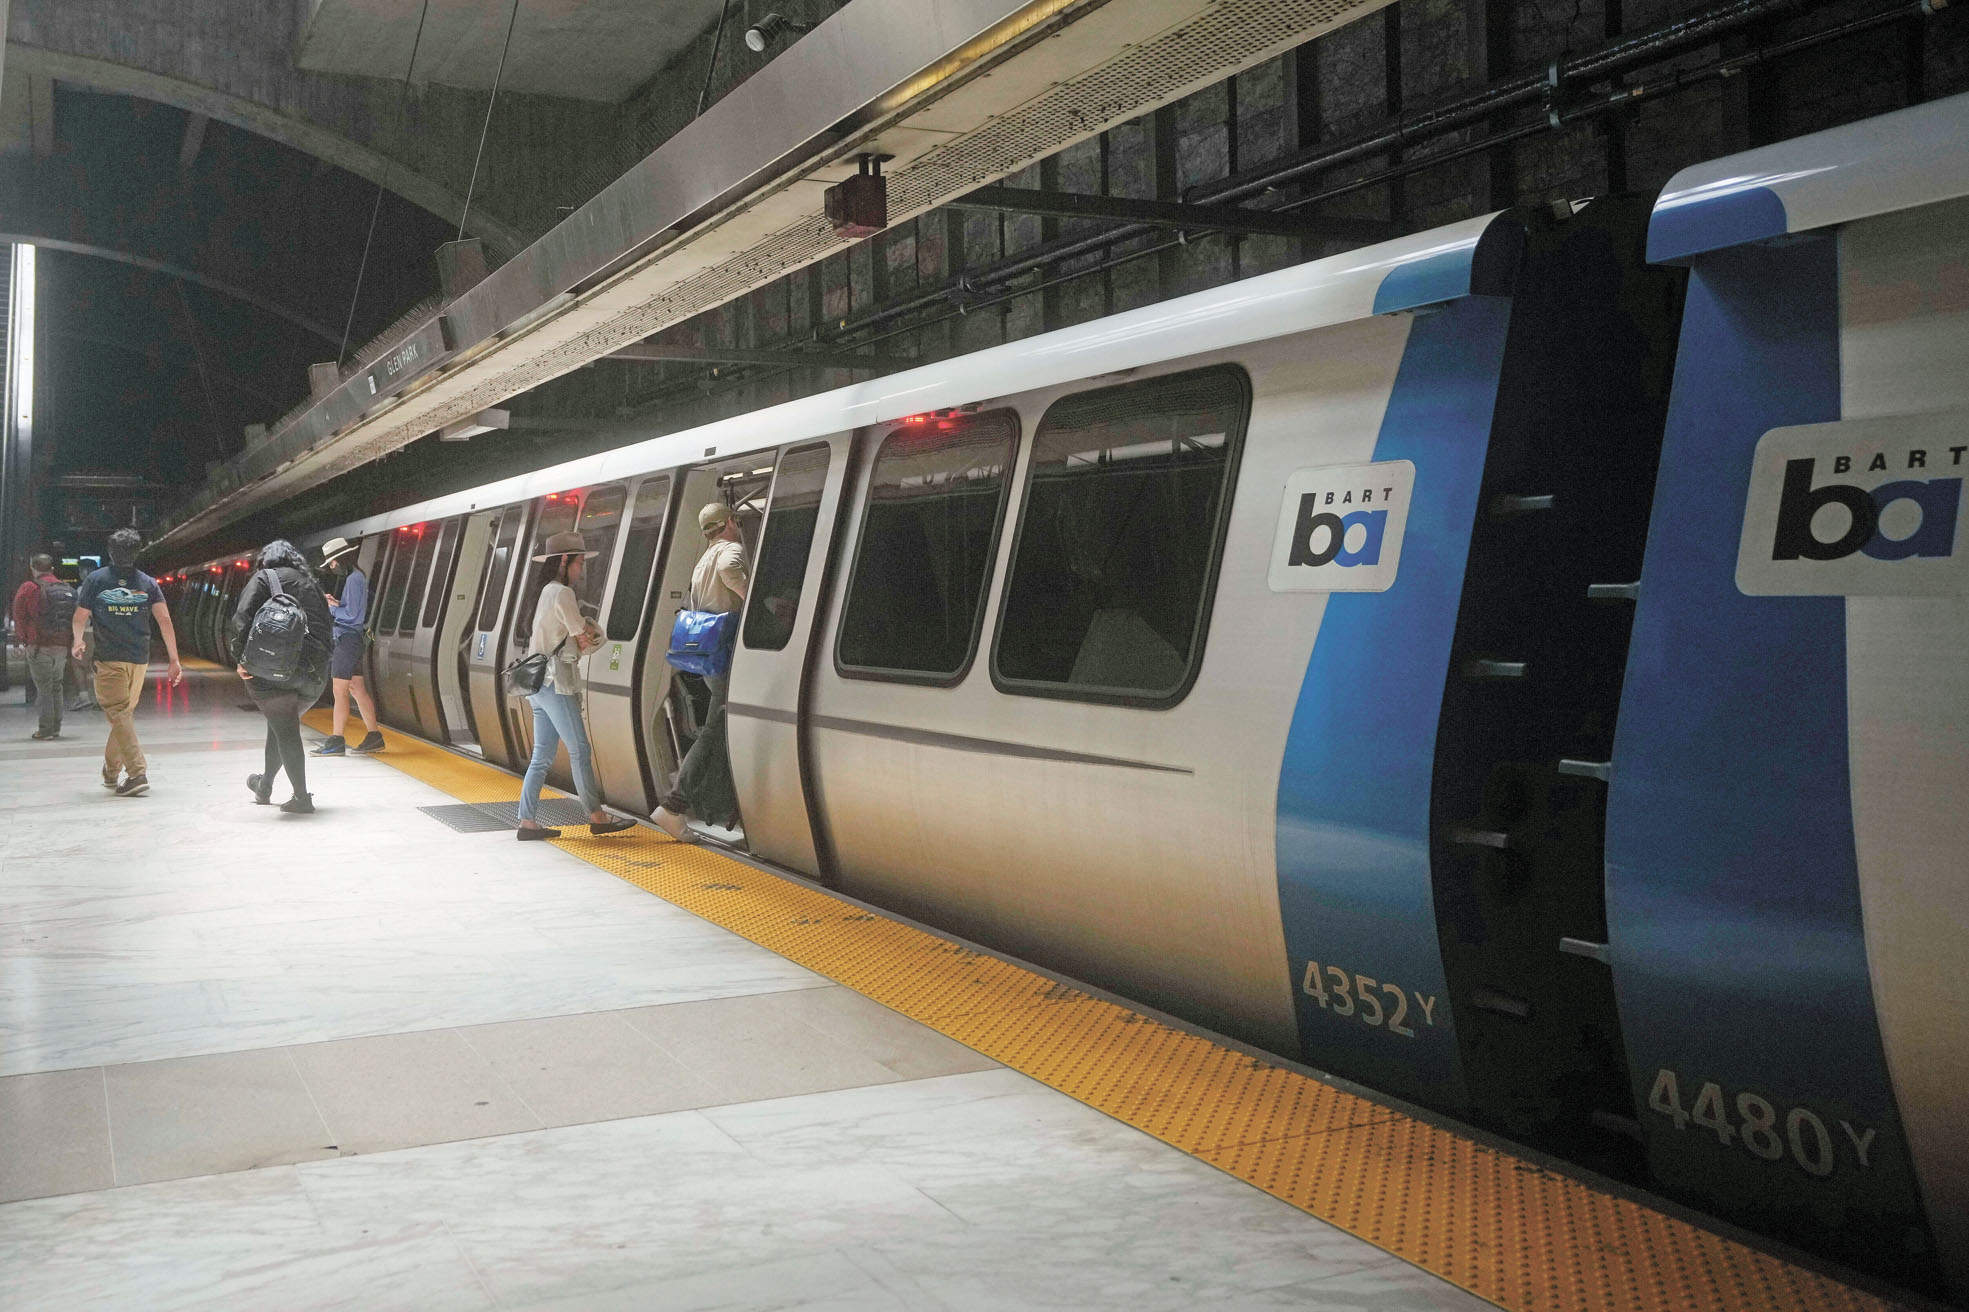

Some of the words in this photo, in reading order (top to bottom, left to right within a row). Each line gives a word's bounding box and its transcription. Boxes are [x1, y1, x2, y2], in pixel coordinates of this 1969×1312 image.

[387, 354, 403, 376] GLEN
[401, 343, 419, 366] PARK
[1833, 446, 1968, 474] BART
[1324, 487, 1393, 505] BART
[1772, 458, 1963, 561] ba
[1288, 492, 1389, 568] ba
